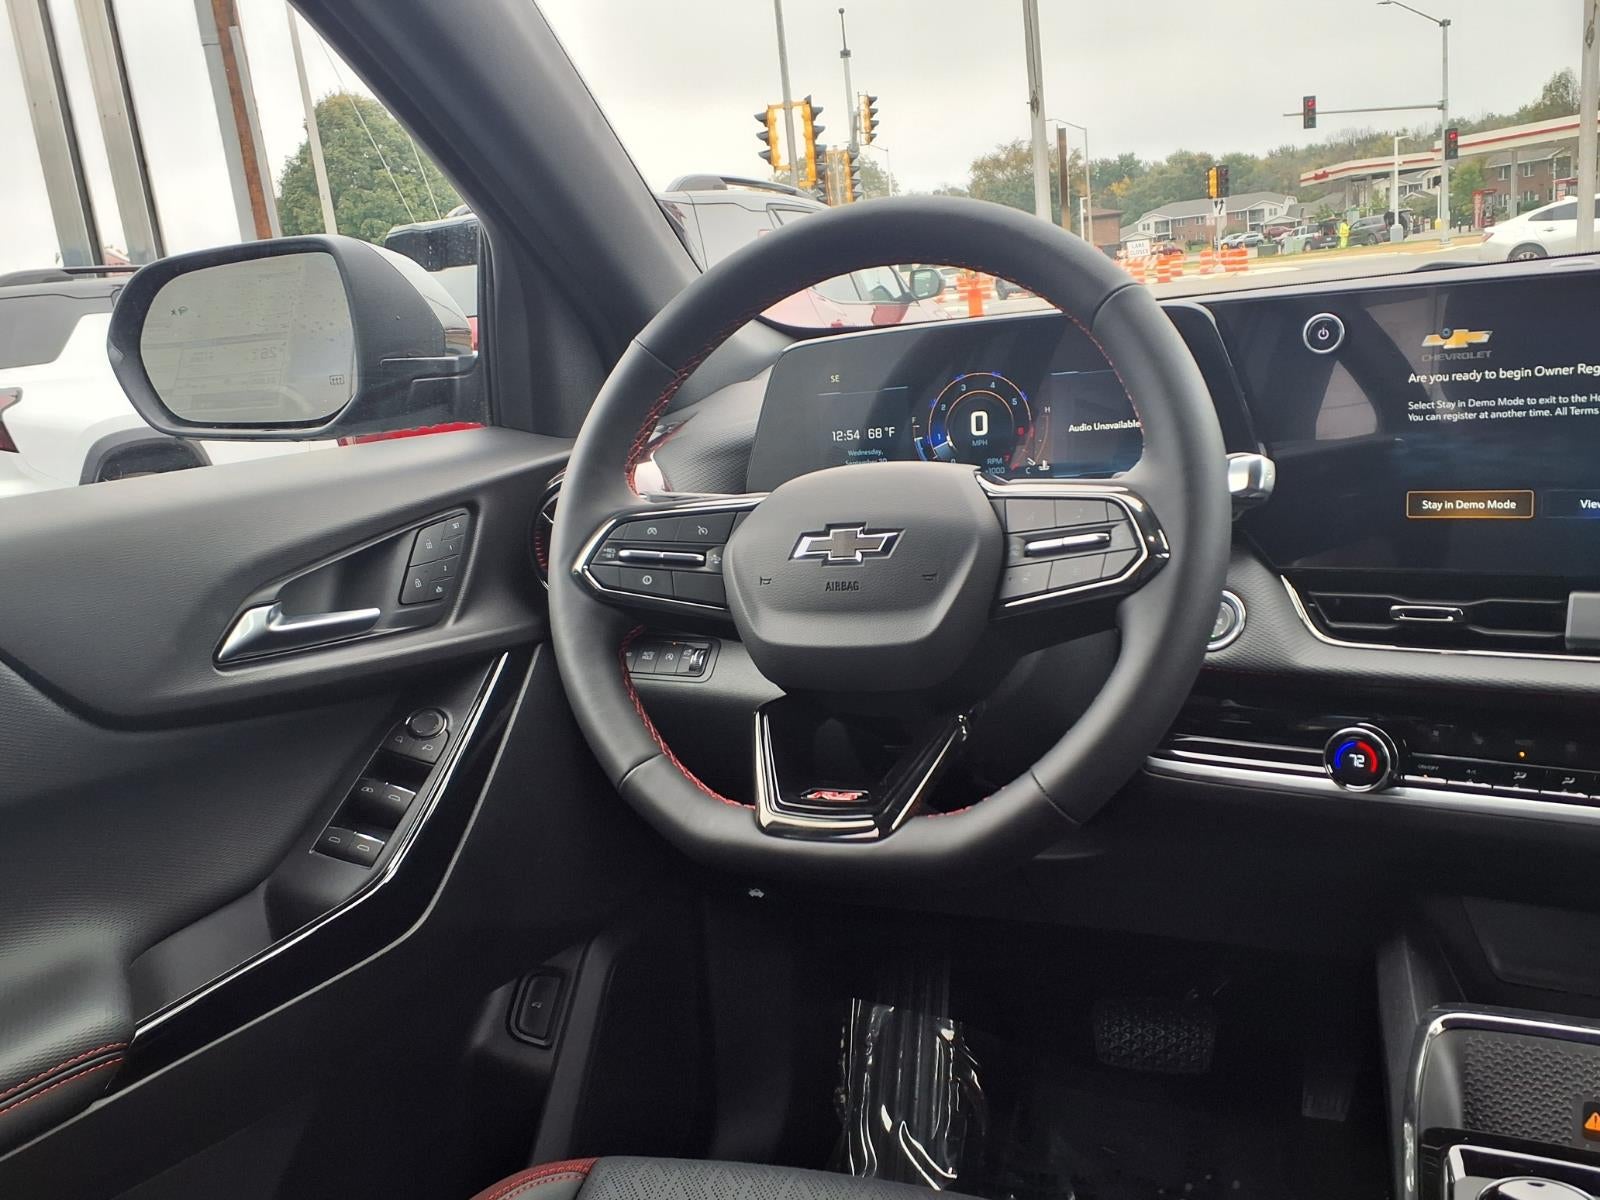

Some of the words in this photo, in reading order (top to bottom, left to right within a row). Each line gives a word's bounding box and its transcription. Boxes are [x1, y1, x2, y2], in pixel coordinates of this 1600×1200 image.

[1422, 350, 1492, 361] CHEVROLET
[830, 374, 840, 382] SE
[1408, 372, 1427, 383] Are
[1429, 375, 1449, 384] you
[1451, 369, 1482, 382] ready
[1485, 369, 1497, 379] to
[1499, 367, 1532, 381] begin
[1534, 365, 1575, 377] Owner
[990, 381, 996, 389] 4
[1012, 398, 1018, 406] 5
[1408, 401, 1435, 410] Select
[1436, 399, 1456, 410] Stay
[1457, 399, 1466, 408] in
[1468, 398, 1496, 408] Demo
[1497, 396, 1525, 406] Mode
[1526, 397, 1537, 405] to
[1538, 395, 1557, 405] exit
[1558, 395, 1569, 404] to
[1571, 393, 1588, 403] the
[1408, 412, 1424, 421] You
[1443, 411, 1477, 422] register
[1478, 411, 1489, 419] at
[1490, 408, 1527, 418] another
[1528, 408, 1553, 417] time.
[1554, 406, 1568, 416] All
[1569, 406, 1599, 416] Terms
[970, 410, 989, 436] 0
[1068, 423, 1092, 432] Audio
[1093, 419, 1142, 430] Unavailable
[832, 430, 861, 442] 12:54
[867, 427, 883, 440] 68
[847, 448, 884, 457] Wednesday,
[987, 458, 1003, 466] RPM
[1026, 467, 1031, 475] C
[1422, 500, 1443, 511] Stay
[1445, 499, 1454, 509] in
[1456, 499, 1485, 509] Demo
[1487, 498, 1517, 509] Mode
[825, 581, 860, 591] AIRBAG
[1349, 754, 1365, 768] 72
